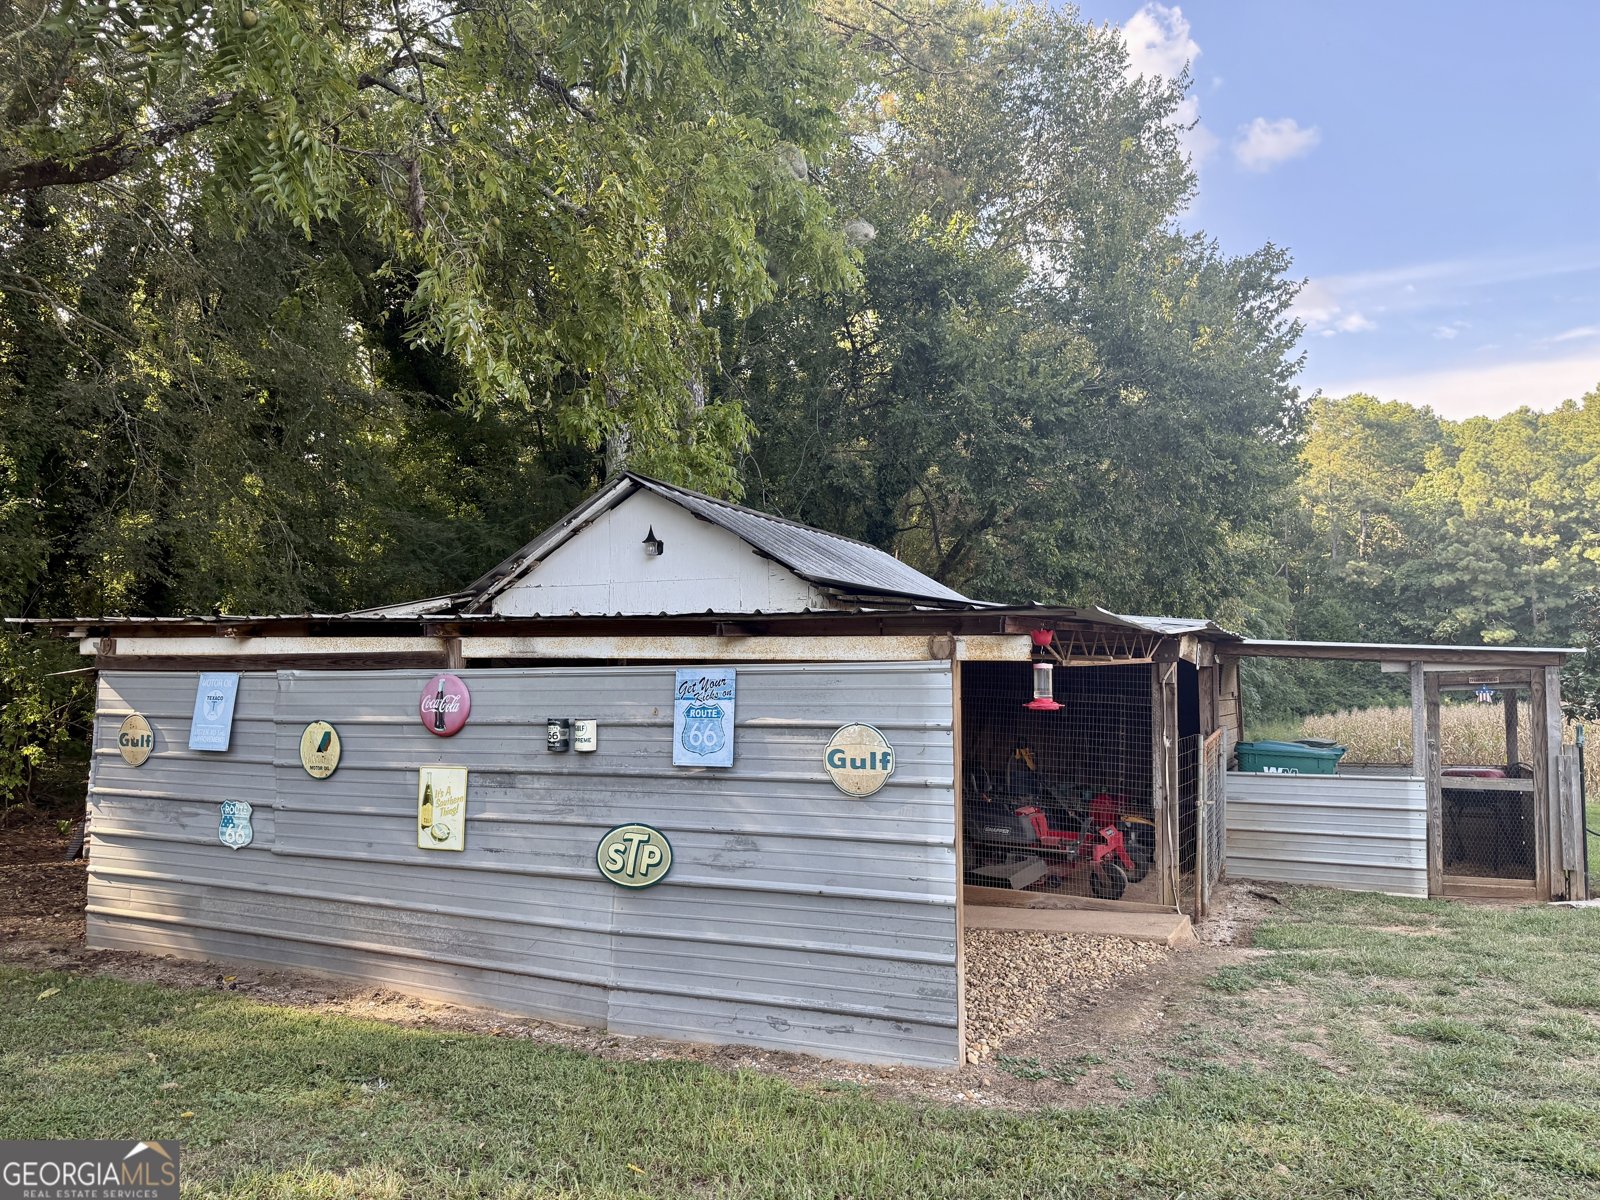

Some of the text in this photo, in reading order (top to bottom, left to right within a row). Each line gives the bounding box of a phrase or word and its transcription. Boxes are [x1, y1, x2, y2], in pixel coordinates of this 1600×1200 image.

[200, 678, 223, 687] MOTOR
[679, 677, 727, 699] Get Your
[694, 689, 718, 703] Kicks
[690, 709, 718, 718] ROUTE
[119, 732, 152, 748] Gulf
[689, 722, 717, 746] 66
[827, 748, 891, 770] Gulf
[434, 785, 452, 799] It's A
[435, 795, 464, 808] Southern
[224, 804, 249, 815] ROUTE
[440, 803, 460, 817] Thing!
[225, 823, 245, 844] 66
[605, 831, 662, 878] STP
